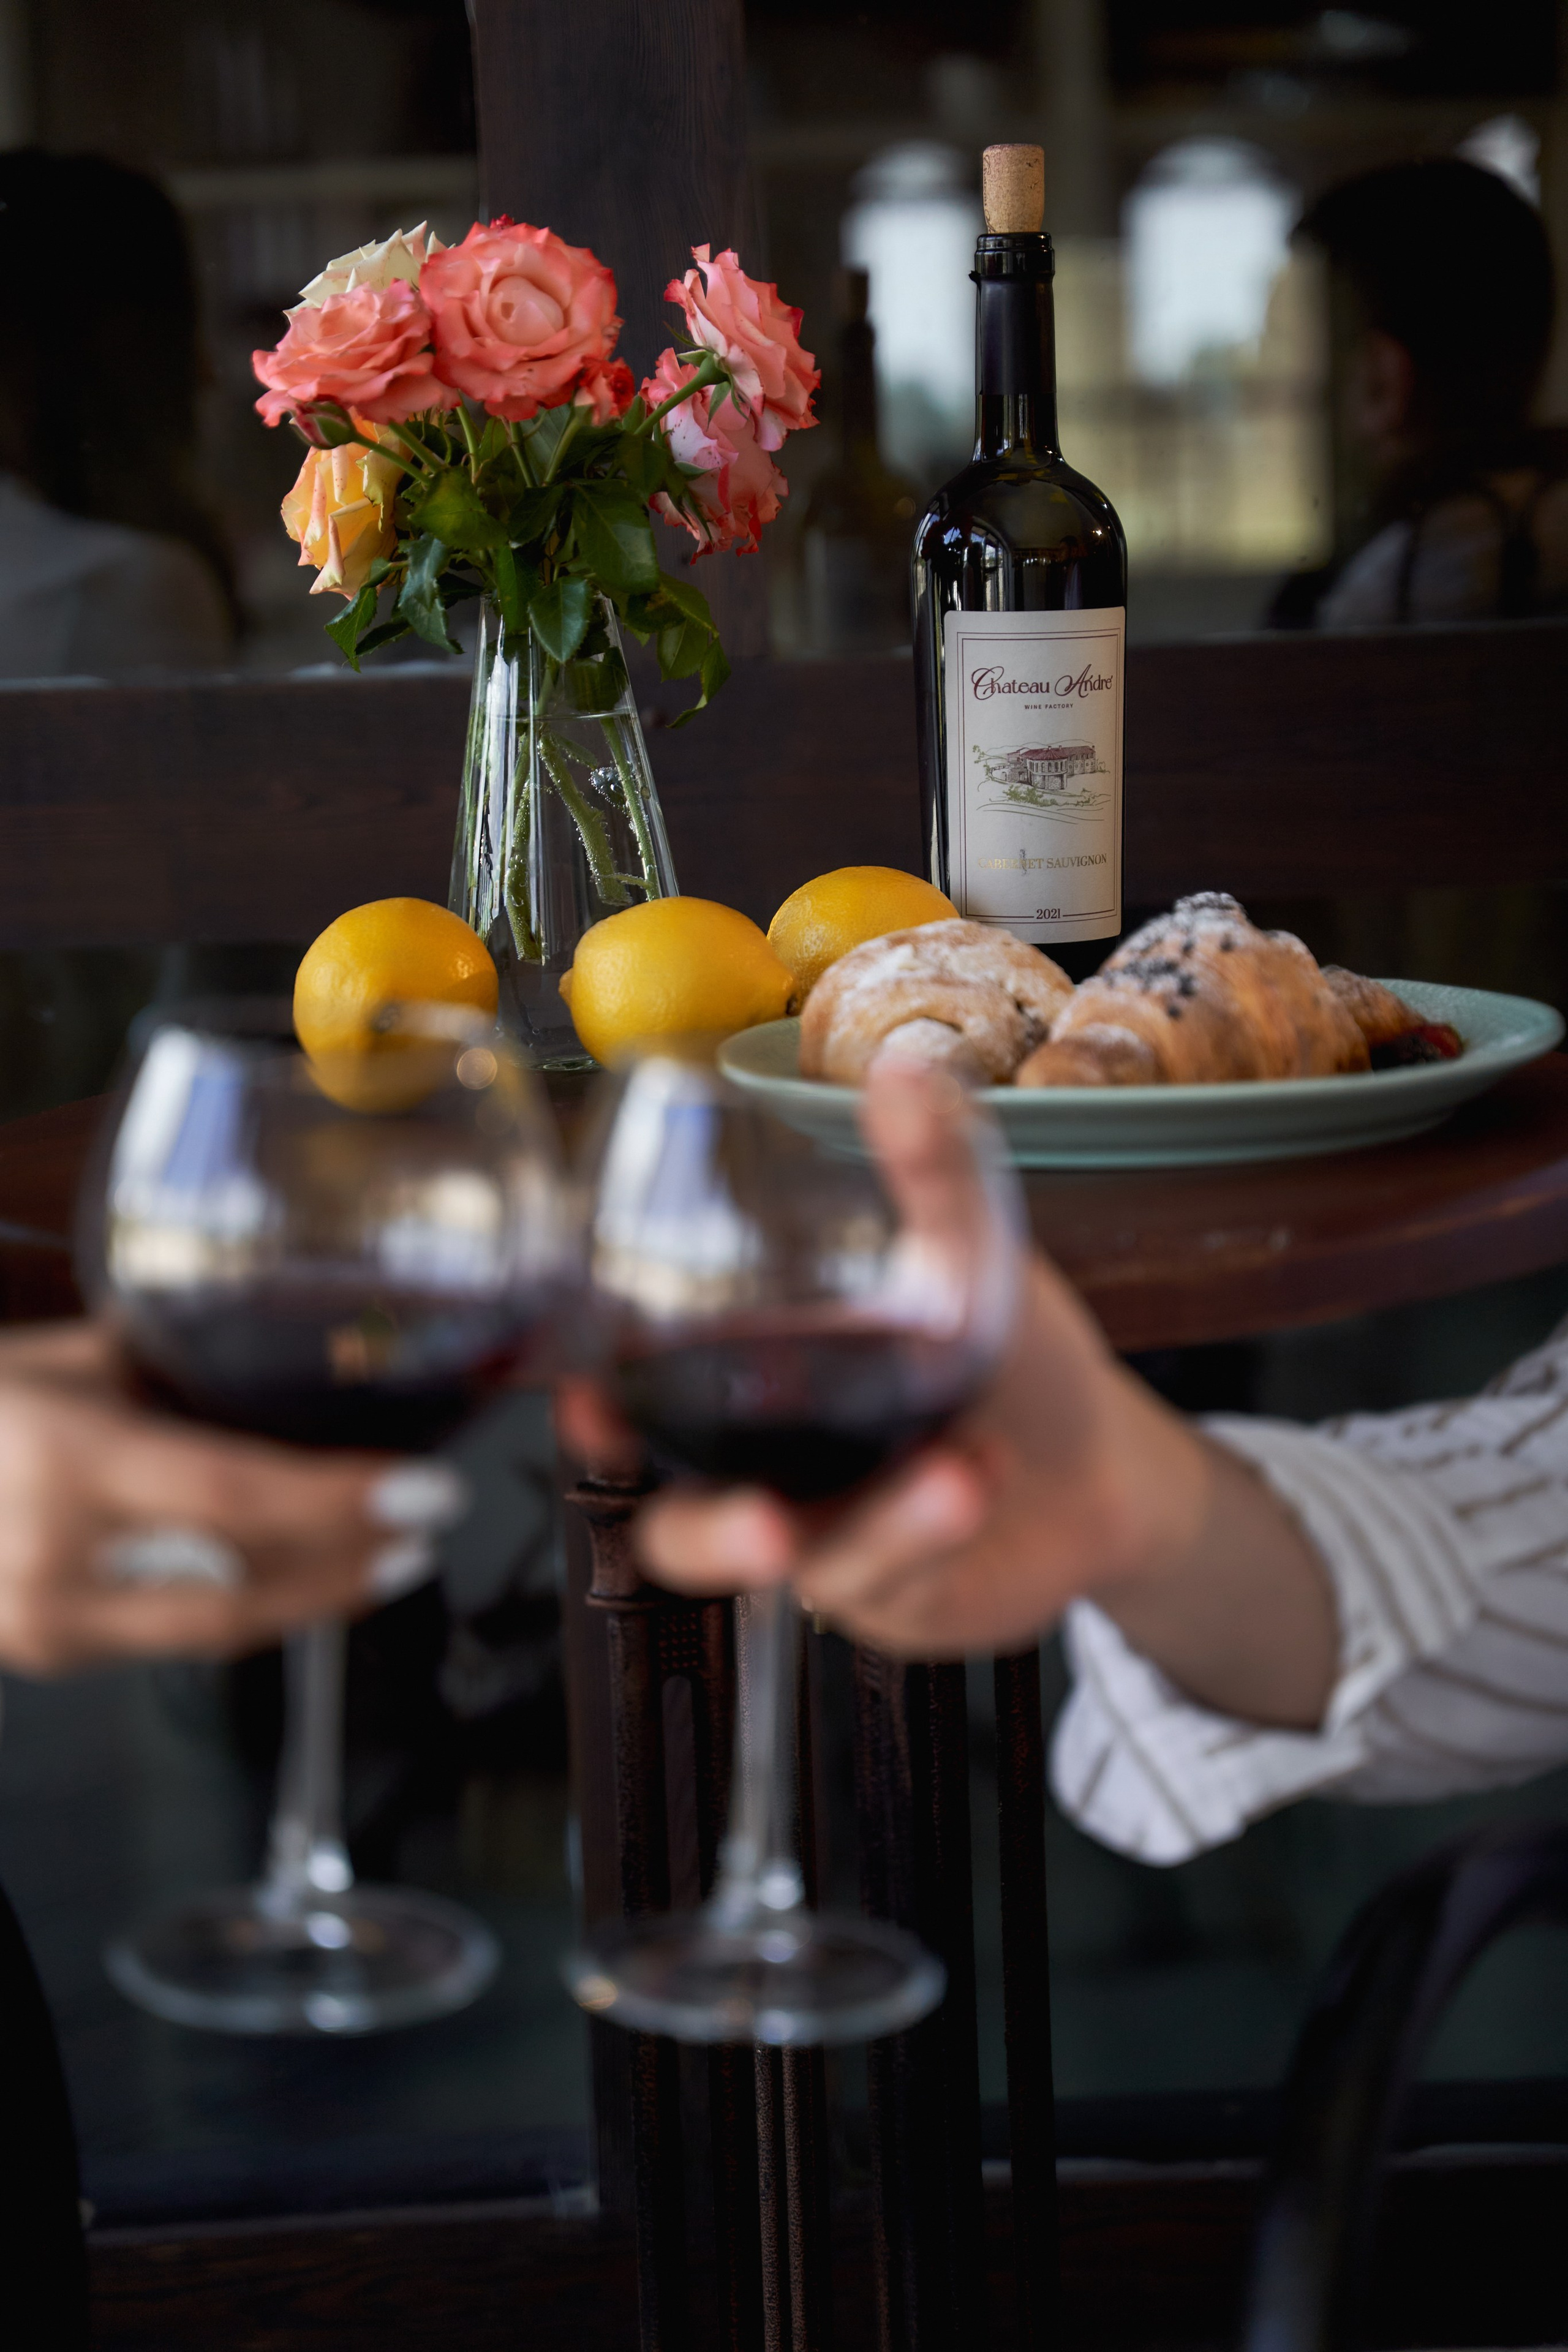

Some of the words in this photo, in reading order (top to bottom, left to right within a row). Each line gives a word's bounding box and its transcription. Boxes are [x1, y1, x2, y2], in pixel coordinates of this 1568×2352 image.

[971, 666, 1050, 700] Chateau
[978, 858, 1044, 870] CABERNET
[1046, 853, 1107, 869] SAUVIGNON
[1036, 908, 1061, 919] 2021
